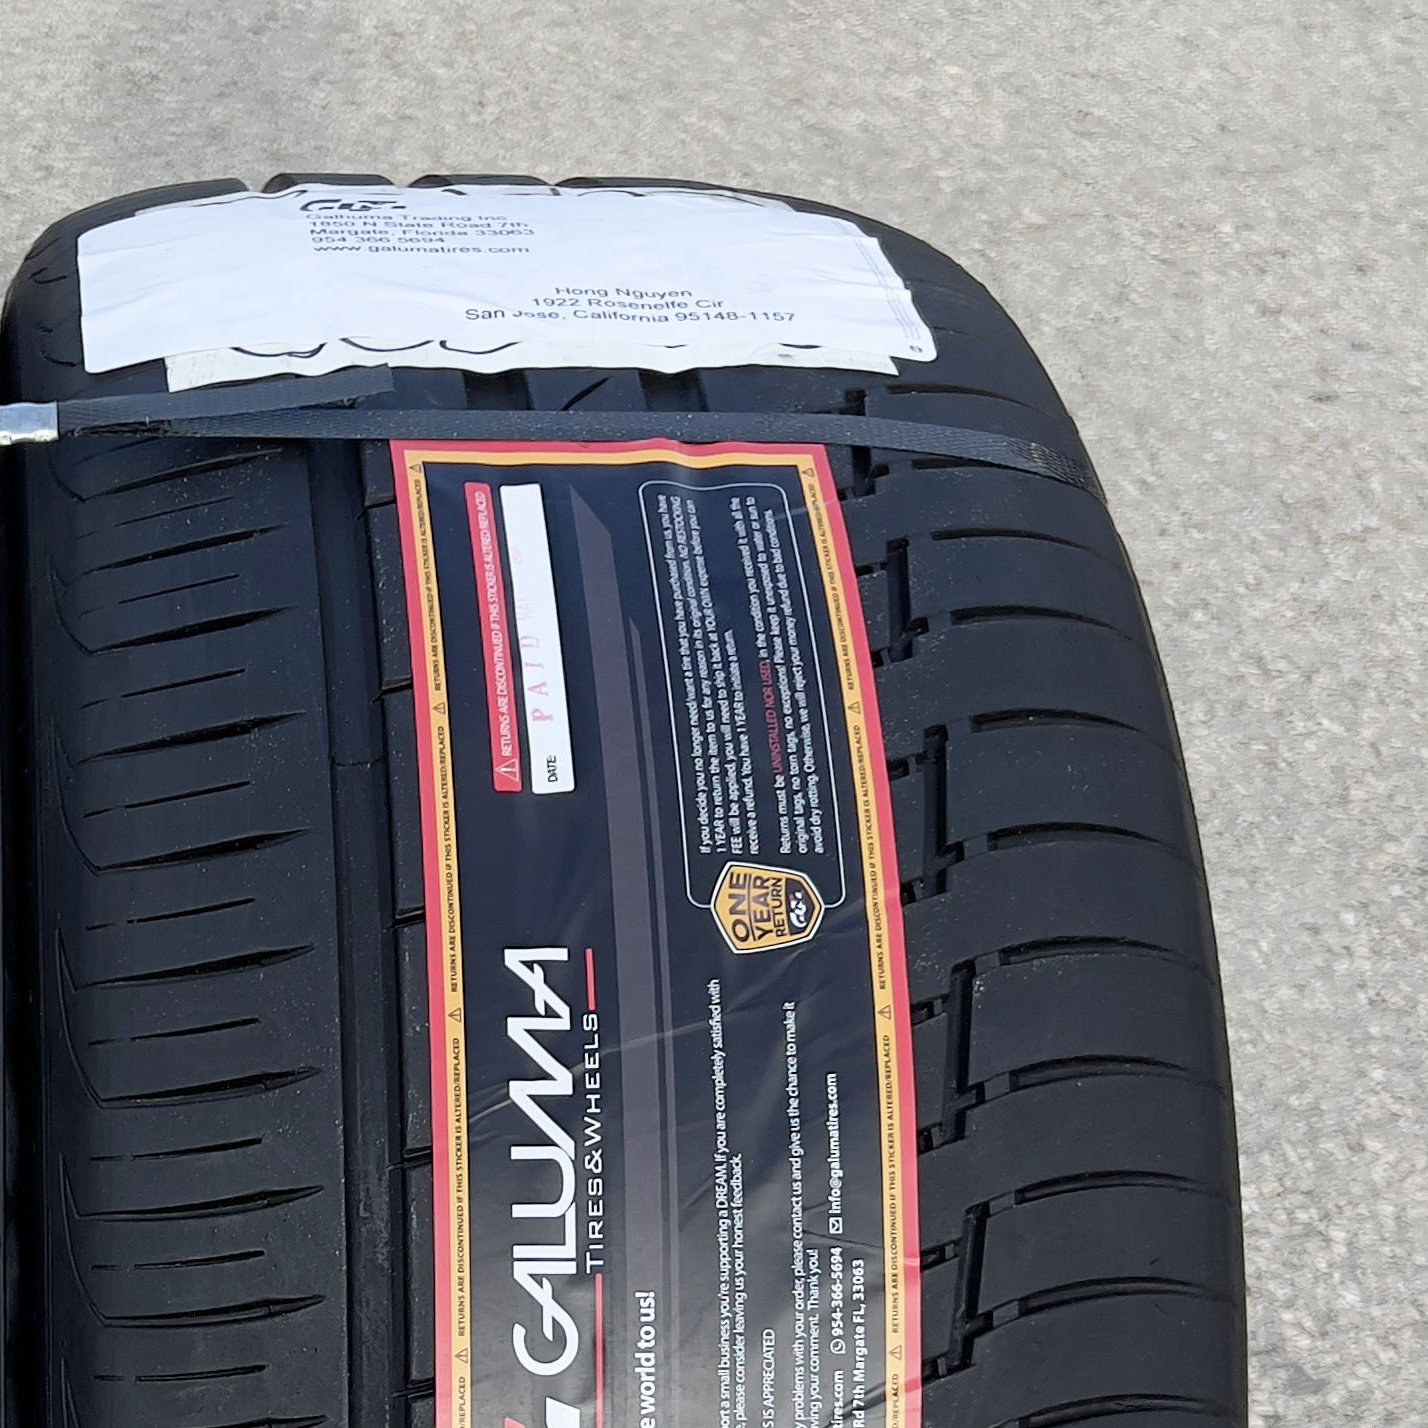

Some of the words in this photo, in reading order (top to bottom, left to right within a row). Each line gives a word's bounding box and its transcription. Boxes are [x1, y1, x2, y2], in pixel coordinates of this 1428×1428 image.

[314, 245, 530, 253] www.galumatires.com
[532, 298, 580, 306] 1922
[696, 300, 724, 308] Cir
[556, 287, 608, 298] Hong
[616, 288, 692, 300] Nguyen
[465, 308, 505, 320] San
[573, 310, 669, 322] California
[674, 310, 794, 322] 95148-1157
[475, 491, 496, 564] ALTERED/REPLACED
[484, 562, 496, 572] IS
[485, 570, 499, 603] STICKER
[487, 603, 501, 623] THIS
[489, 621, 502, 630] IF
[490, 629, 508, 695] DISCONTINUED
[496, 695, 509, 714] ARE
[498, 714, 513, 757] RETURNS
[727, 871, 749, 942] ONE
[752, 874, 773, 940] YEAR
[771, 876, 787, 937] RETURN
[583, 1012, 604, 1274] TIRES&WHEELS
[823, 1073, 844, 1214] info@galumatires.com
[503, 946, 579, 1376] GALUMA
[829, 1246, 843, 1337] 954-366-5694
[851, 1259, 865, 1301] 33063
[633, 1291, 655, 1322] us!
[851, 1303, 868, 1323] FL,
[633, 1325, 655, 1350] to
[851, 1325, 868, 1382] Margate
[633, 1352, 655, 1415] world
[761, 1328, 775, 1408] APPRECIATED
[851, 1384, 864, 1408] 7th
[761, 1408, 774, 1419] IS
[851, 1410, 864, 1428] Rd
